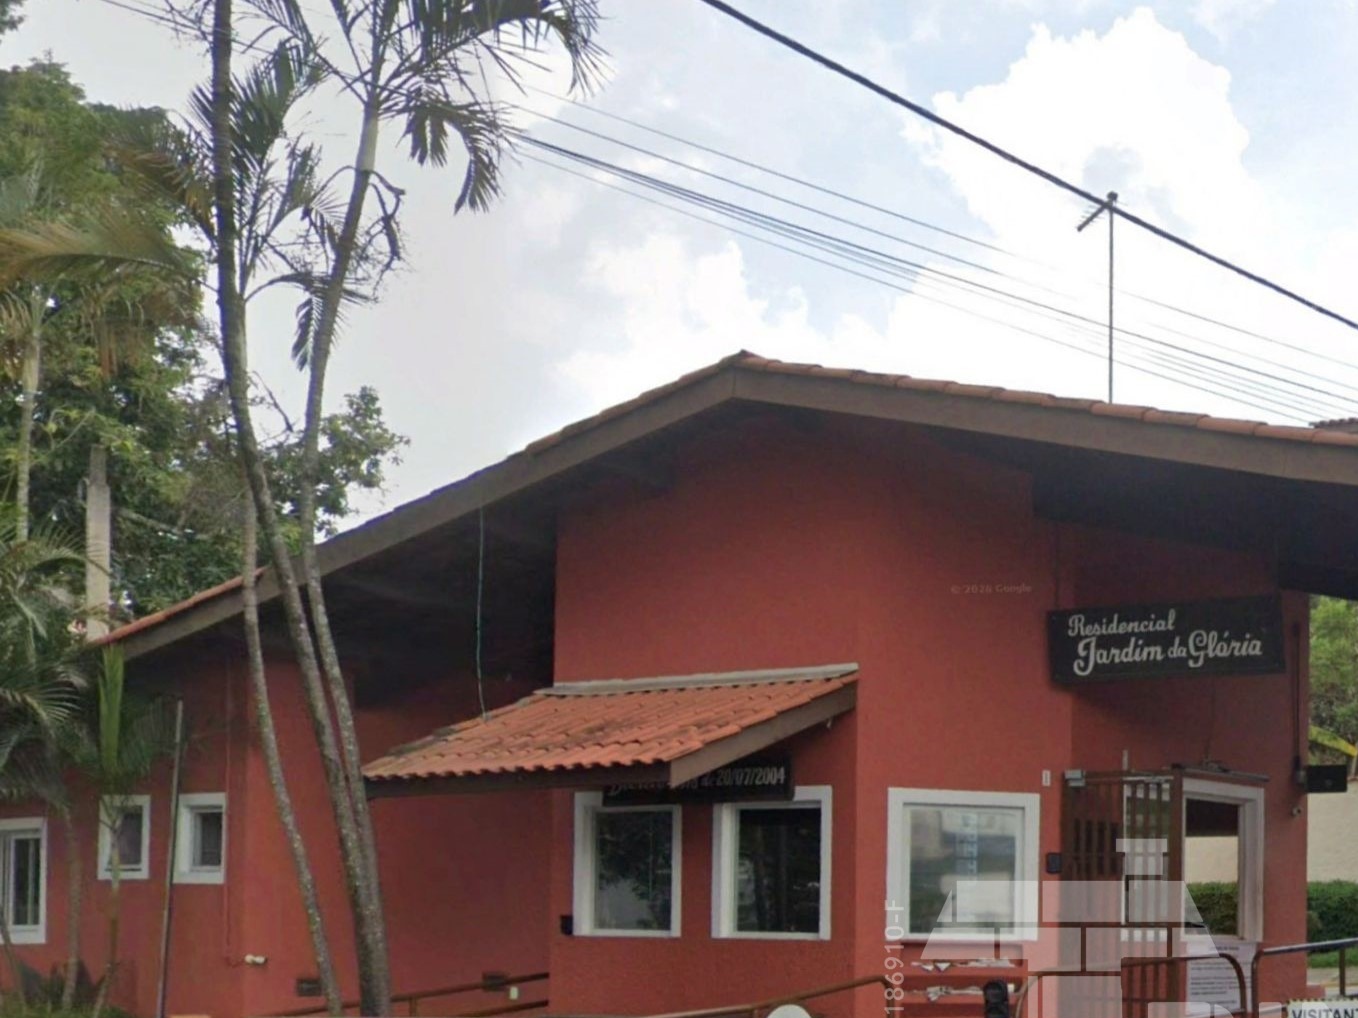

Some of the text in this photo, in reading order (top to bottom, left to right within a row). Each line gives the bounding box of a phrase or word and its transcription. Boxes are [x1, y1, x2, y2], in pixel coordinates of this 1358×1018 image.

[1067, 608, 1176, 638] Residencial
[1073, 630, 1263, 677] Jardim da Glória
